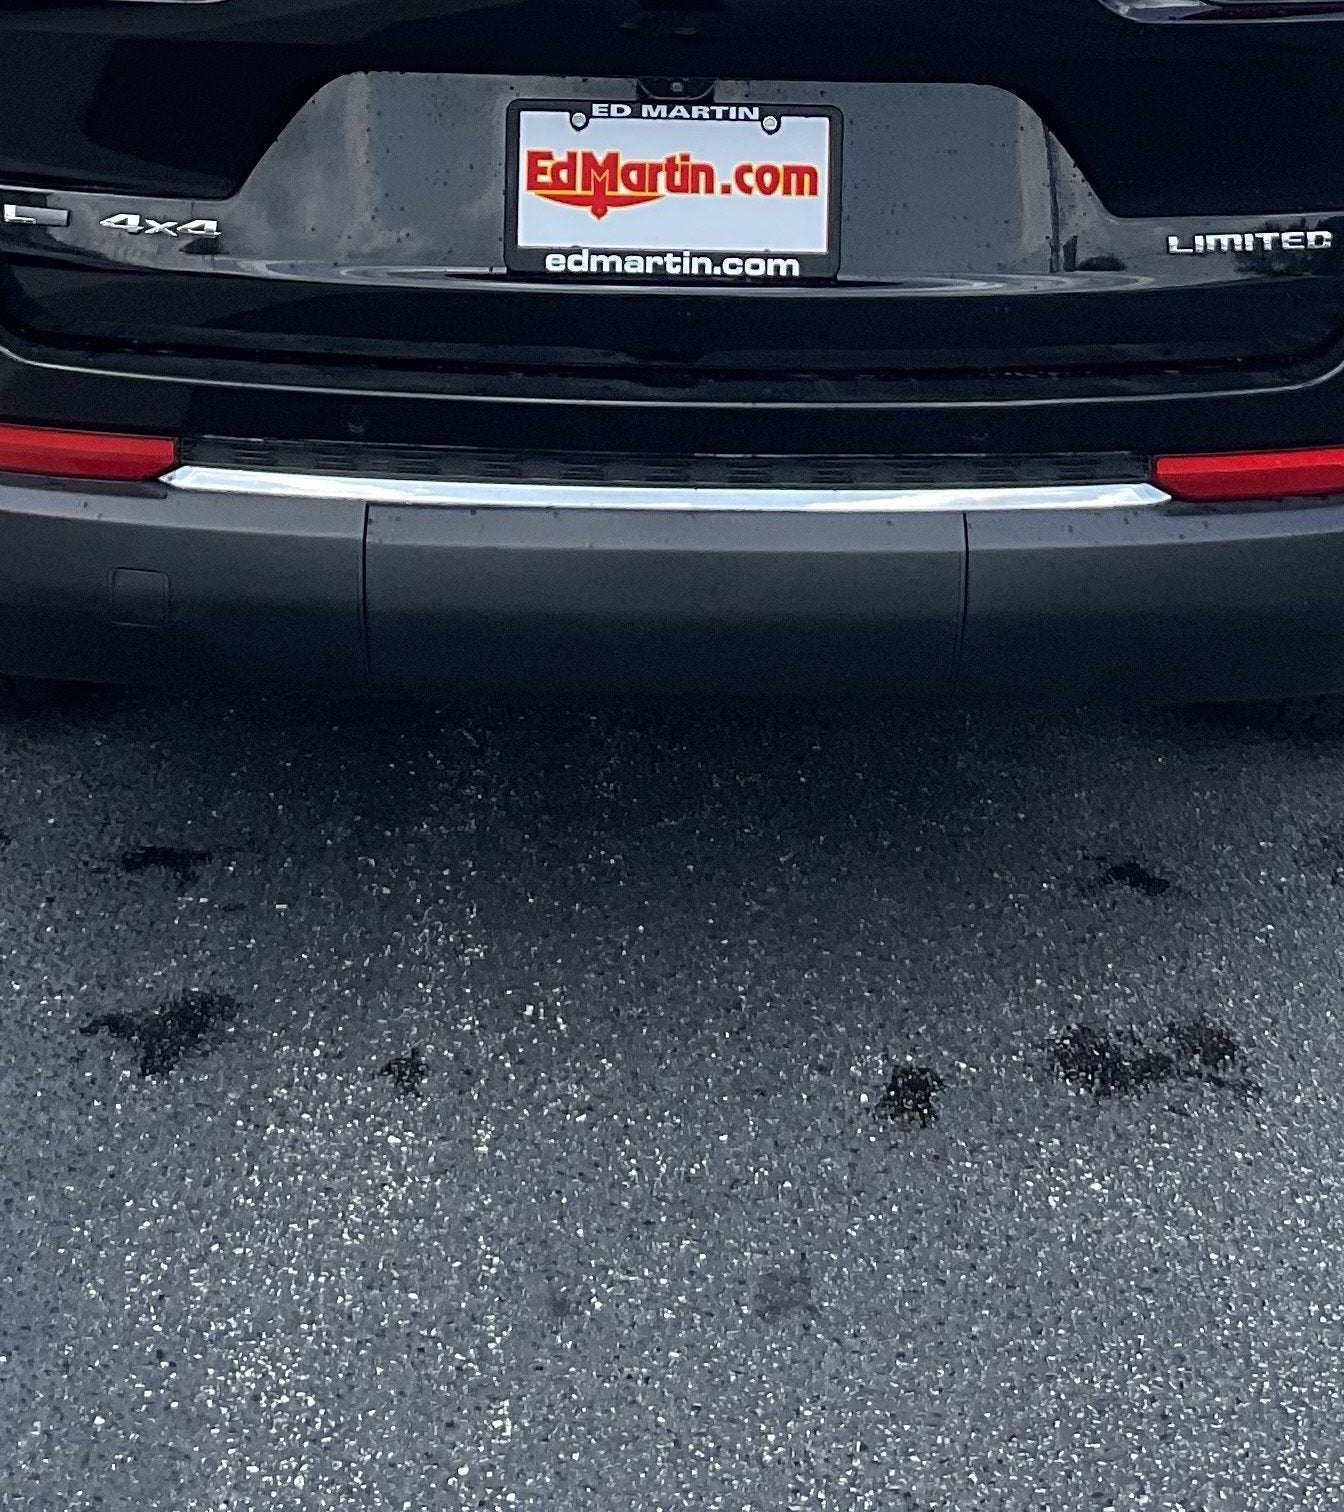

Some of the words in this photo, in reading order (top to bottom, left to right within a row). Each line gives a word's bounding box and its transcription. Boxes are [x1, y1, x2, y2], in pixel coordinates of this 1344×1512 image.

[591, 103, 632, 118] ED
[641, 103, 761, 121] MARTIN
[526, 149, 820, 220] EdMartin.com
[99, 212, 223, 240] 4x4
[1167, 230, 1334, 255] LIMITED
[544, 248, 801, 277] edmartin.com
